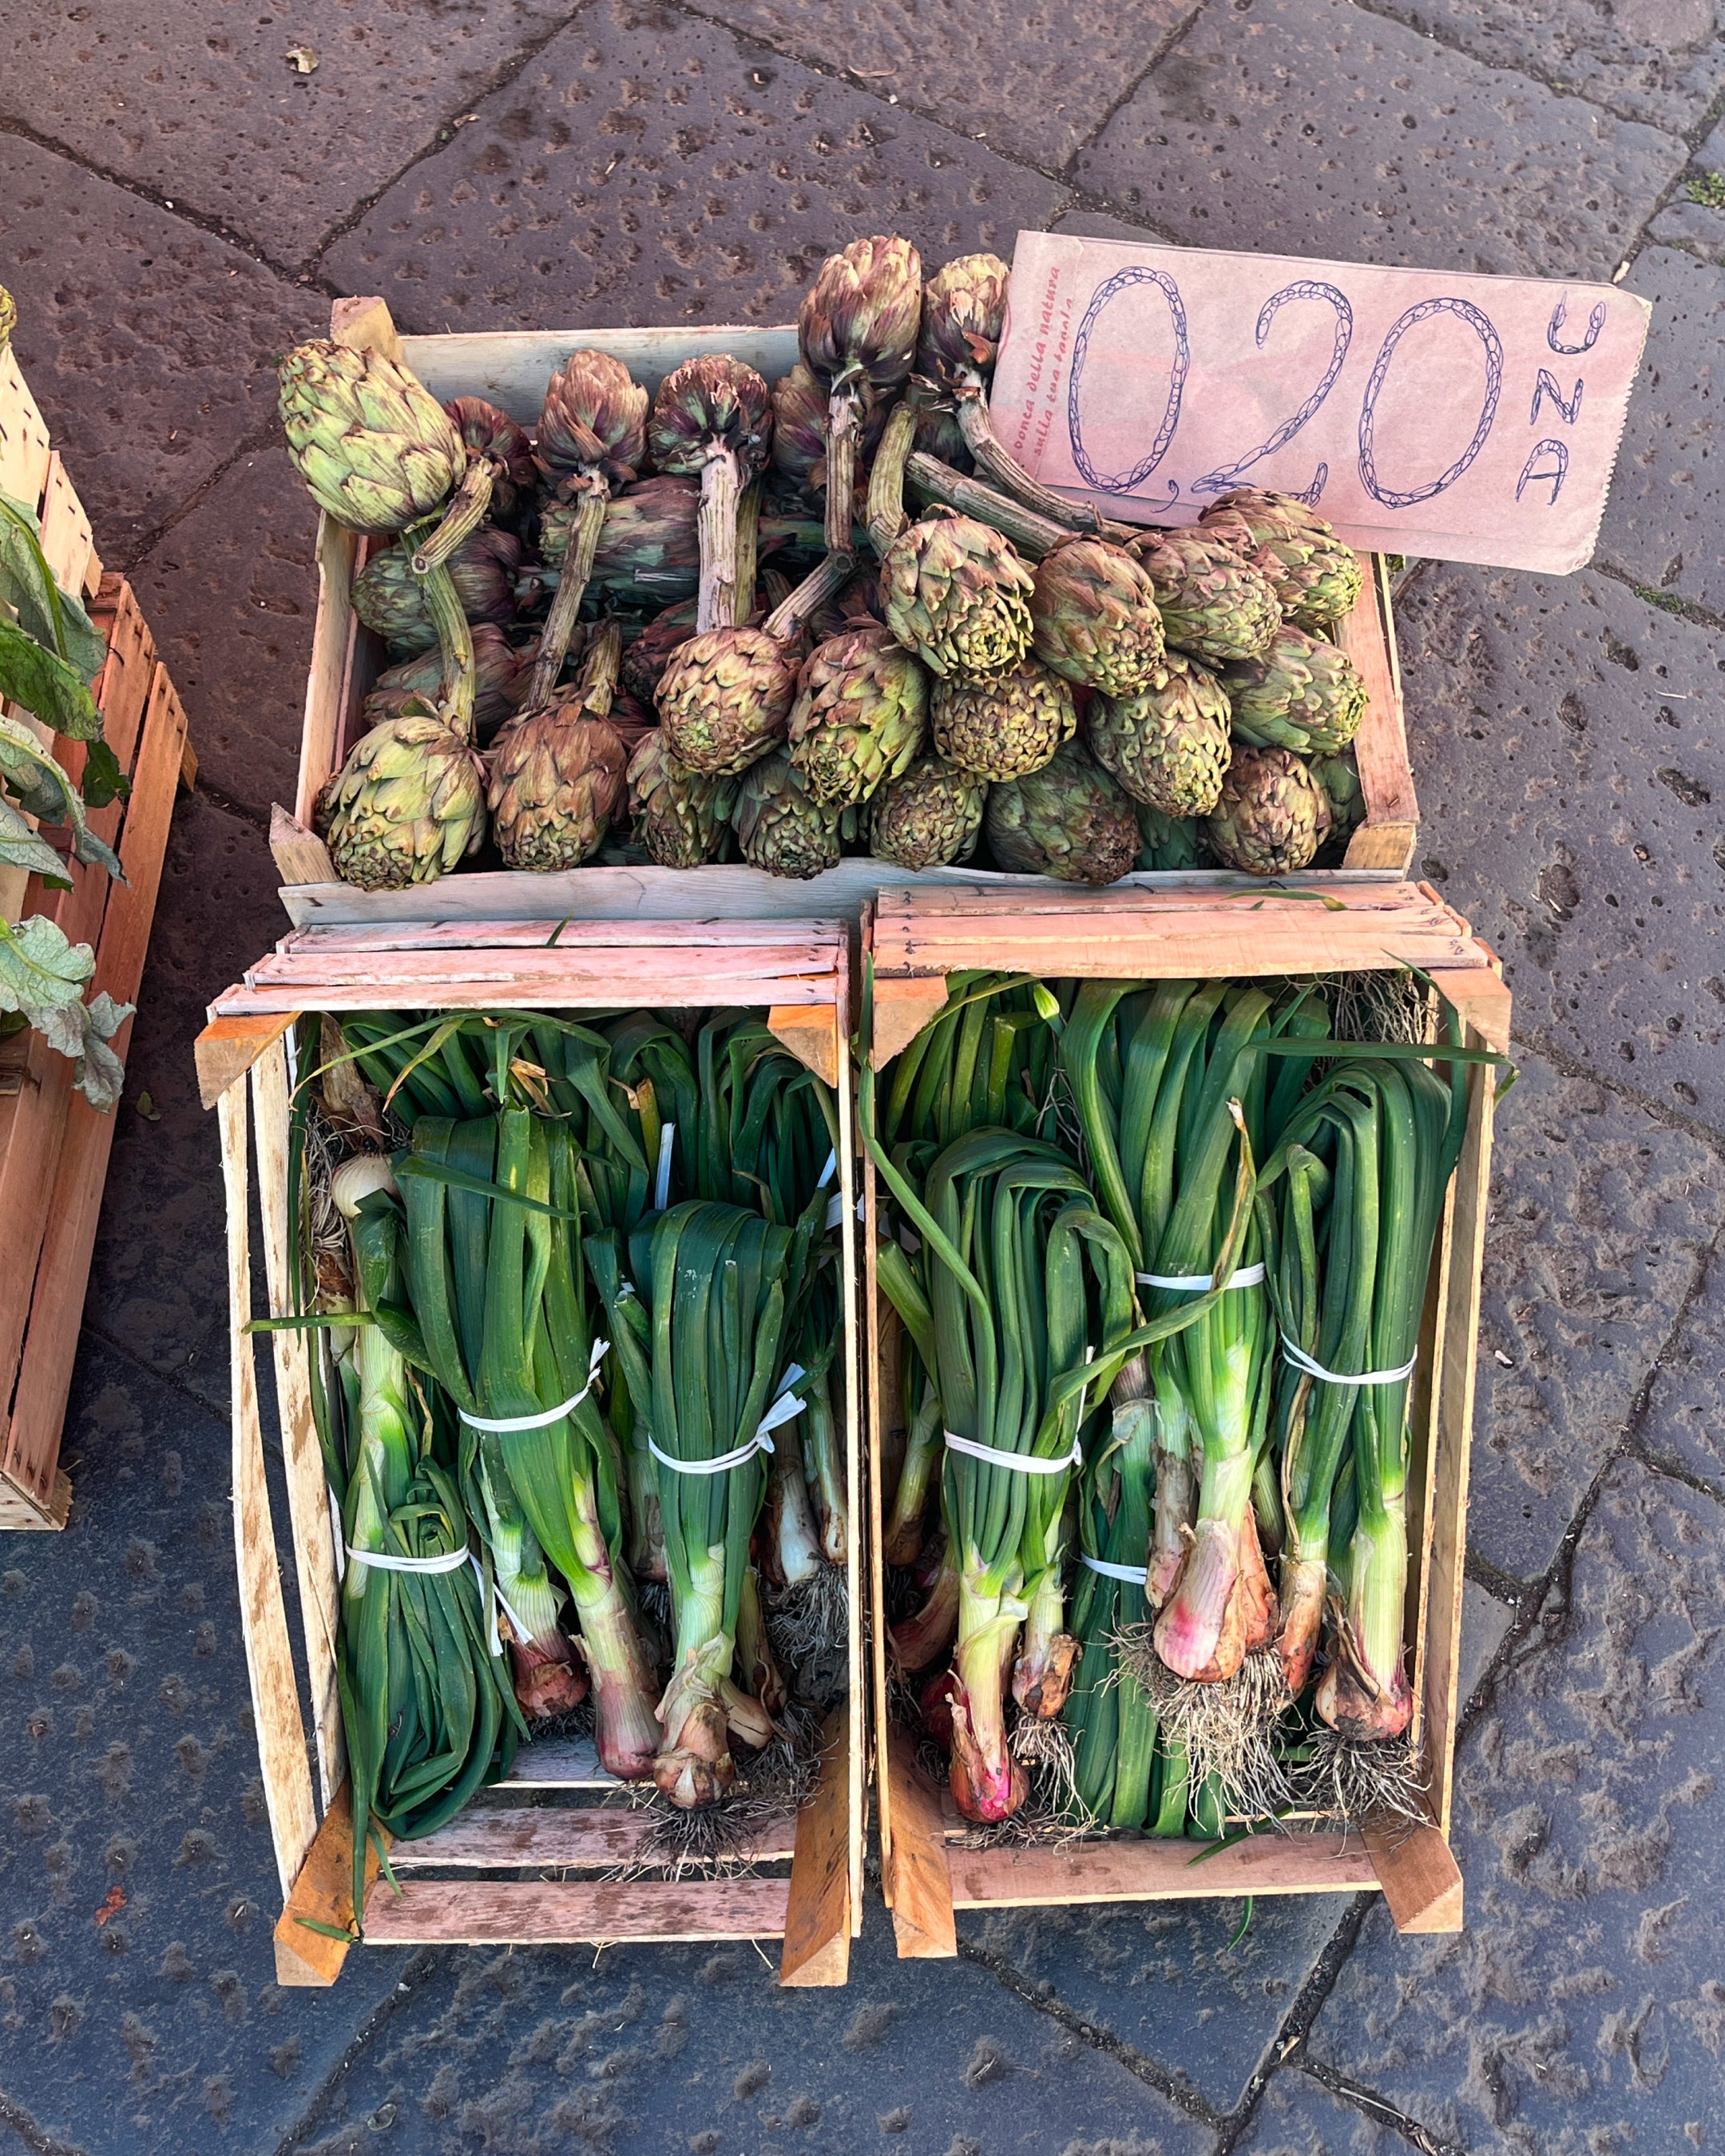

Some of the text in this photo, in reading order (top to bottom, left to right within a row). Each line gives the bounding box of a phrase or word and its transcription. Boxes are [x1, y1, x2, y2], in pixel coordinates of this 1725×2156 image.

[1026, 342, 1047, 392] della
[1039, 267, 1060, 335] natura
[1068, 265, 1503, 513] 0,20
[1034, 410, 1053, 457] sulla
[1046, 370, 1061, 402] tua
